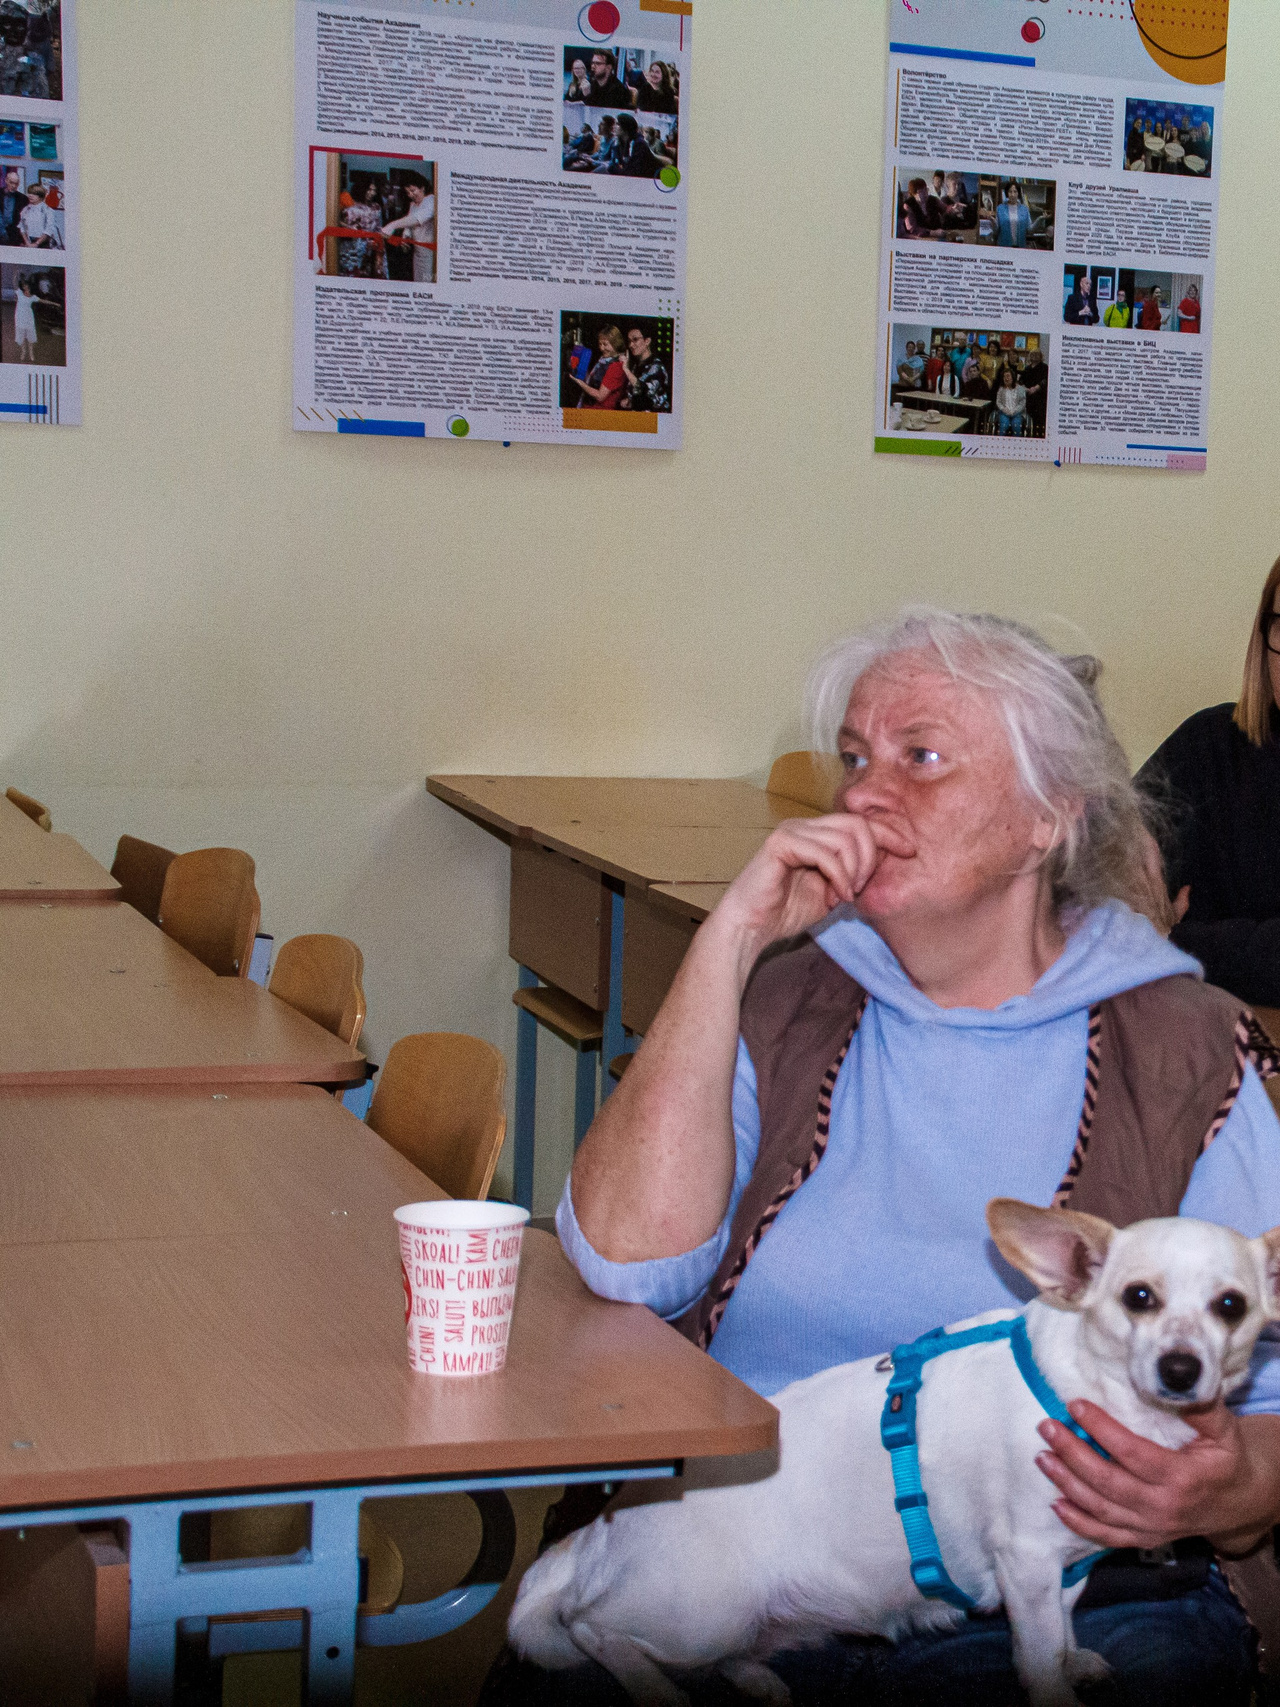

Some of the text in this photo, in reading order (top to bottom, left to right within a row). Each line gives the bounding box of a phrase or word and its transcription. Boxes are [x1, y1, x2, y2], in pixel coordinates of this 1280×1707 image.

[317, 11, 420, 29] Научные события Академии
[902, 68, 946, 80] Волонтёрство
[450, 170, 592, 191] Международная деятельность Академии
[1068, 181, 1138, 195] Клуб друзей Уралмаша
[895, 250, 926, 258] Выставки
[979, 258, 1013, 267] площадках
[315, 284, 366, 295] Издательская
[369, 289, 409, 299] программа
[1062, 334, 1104, 343] Инклюзивные
[414, 1239, 460, 1264] SKOAL!
[415, 1265, 495, 1291] CHIN-CHIN!
[444, 1300, 466, 1343] SALUT!
[442, 1351, 493, 1374] KAMPAI!
